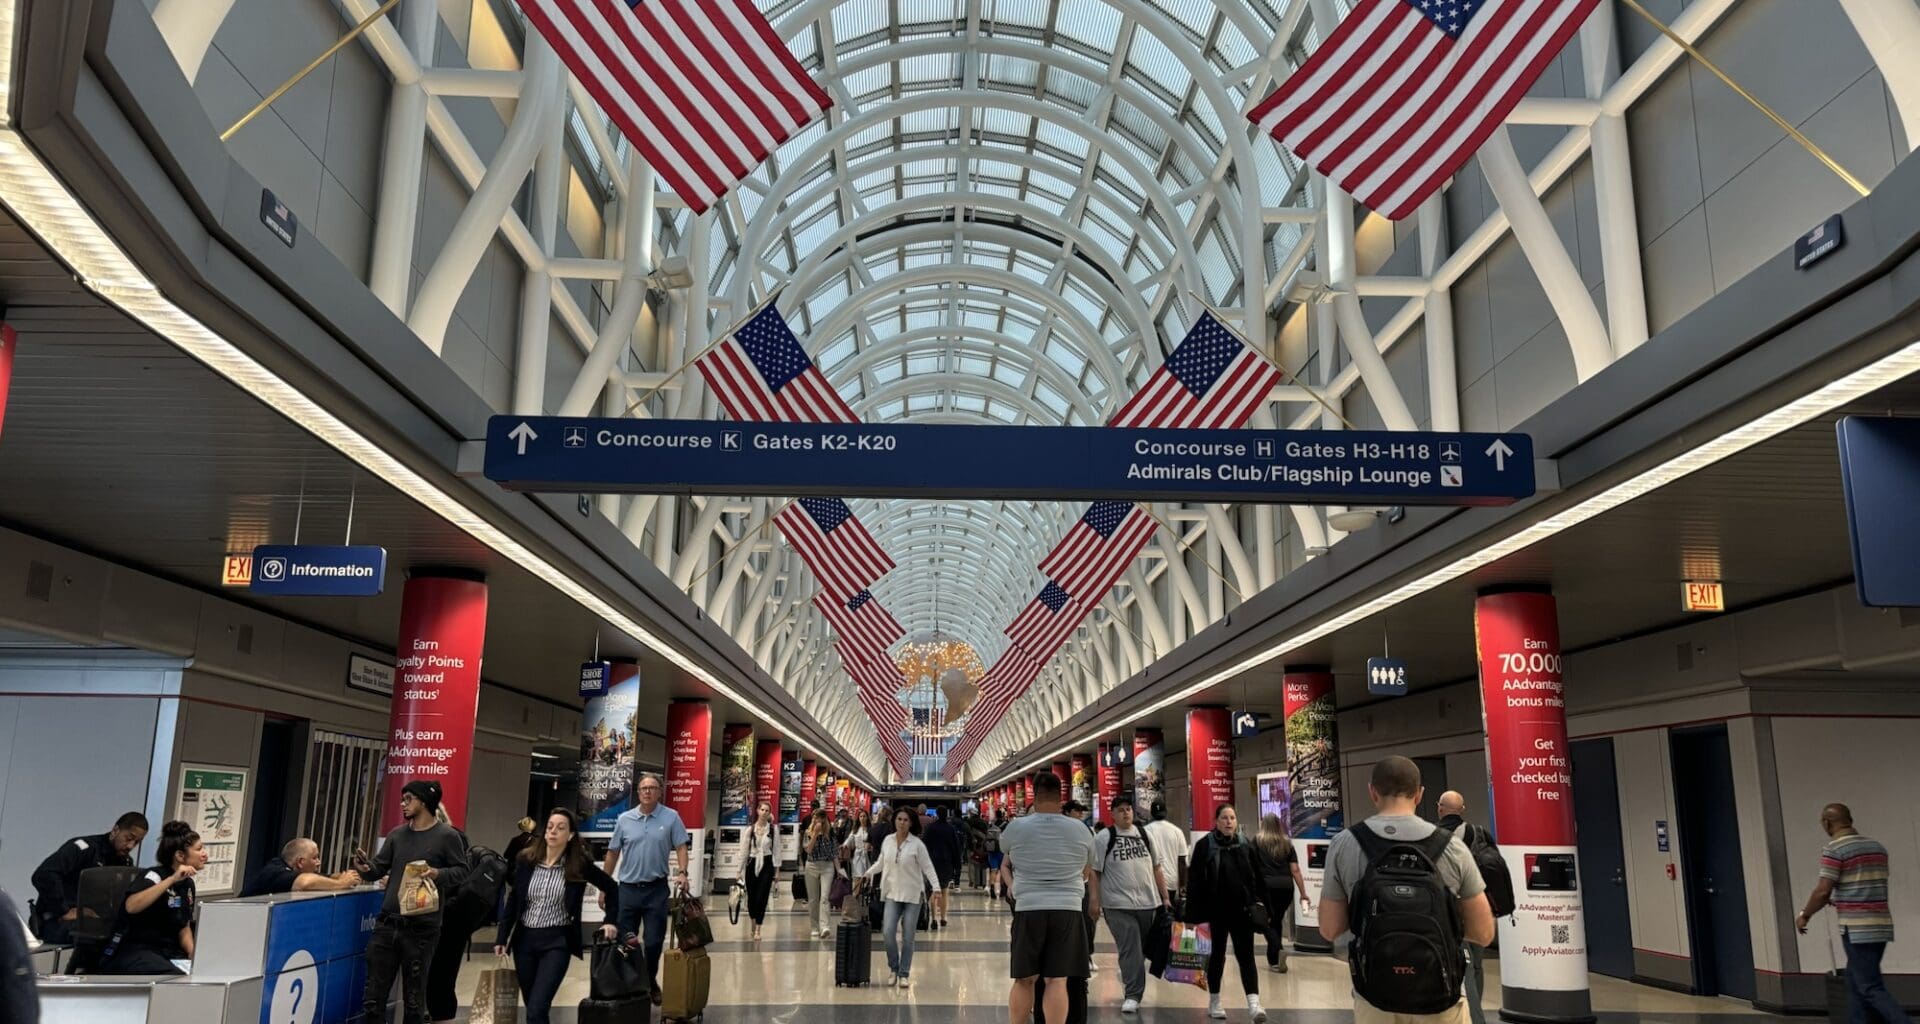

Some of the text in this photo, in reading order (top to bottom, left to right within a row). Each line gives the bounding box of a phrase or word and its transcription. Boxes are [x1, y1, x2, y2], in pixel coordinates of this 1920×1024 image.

[597, 430, 896, 450] Concourse K Gates K2-K20
[1134, 439, 1429, 459] Concourse H Gates H3-H18
[1127, 463, 1431, 487] Admirals Club/Flagship Lounge
[227, 557, 250, 578] EXI
[291, 563, 373, 576] Information
[1689, 584, 1718, 604] EXIT
[413, 638, 439, 650] Earn
[1523, 638, 1548, 649] Earn
[397, 655, 464, 670] oyalty Points
[1498, 653, 1562, 676] 70,000
[404, 672, 444, 683] toward
[582, 670, 602, 679] SHOE
[580, 680, 602, 689] SHINE
[1287, 683, 1309, 691] More
[1503, 678, 1563, 694] AAdvantag
[1507, 696, 1565, 708] bonus miles
[395, 728, 444, 740] Plus earn
[1534, 738, 1554, 750] Get
[783, 762, 796, 770] K2
[1519, 755, 1566, 769] your first
[388, 763, 449, 774] bonus miles
[590, 770, 609, 781] your
[612, 768, 627, 778] first
[195, 778, 202, 788] 3
[1310, 777, 1332, 788] Enjoy
[1511, 772, 1558, 783] checked
[610, 780, 625, 791] bag
[590, 790, 608, 800] free
[1302, 788, 1339, 798] preferred
[1537, 788, 1560, 800] free
[1303, 799, 1340, 811] boarding
